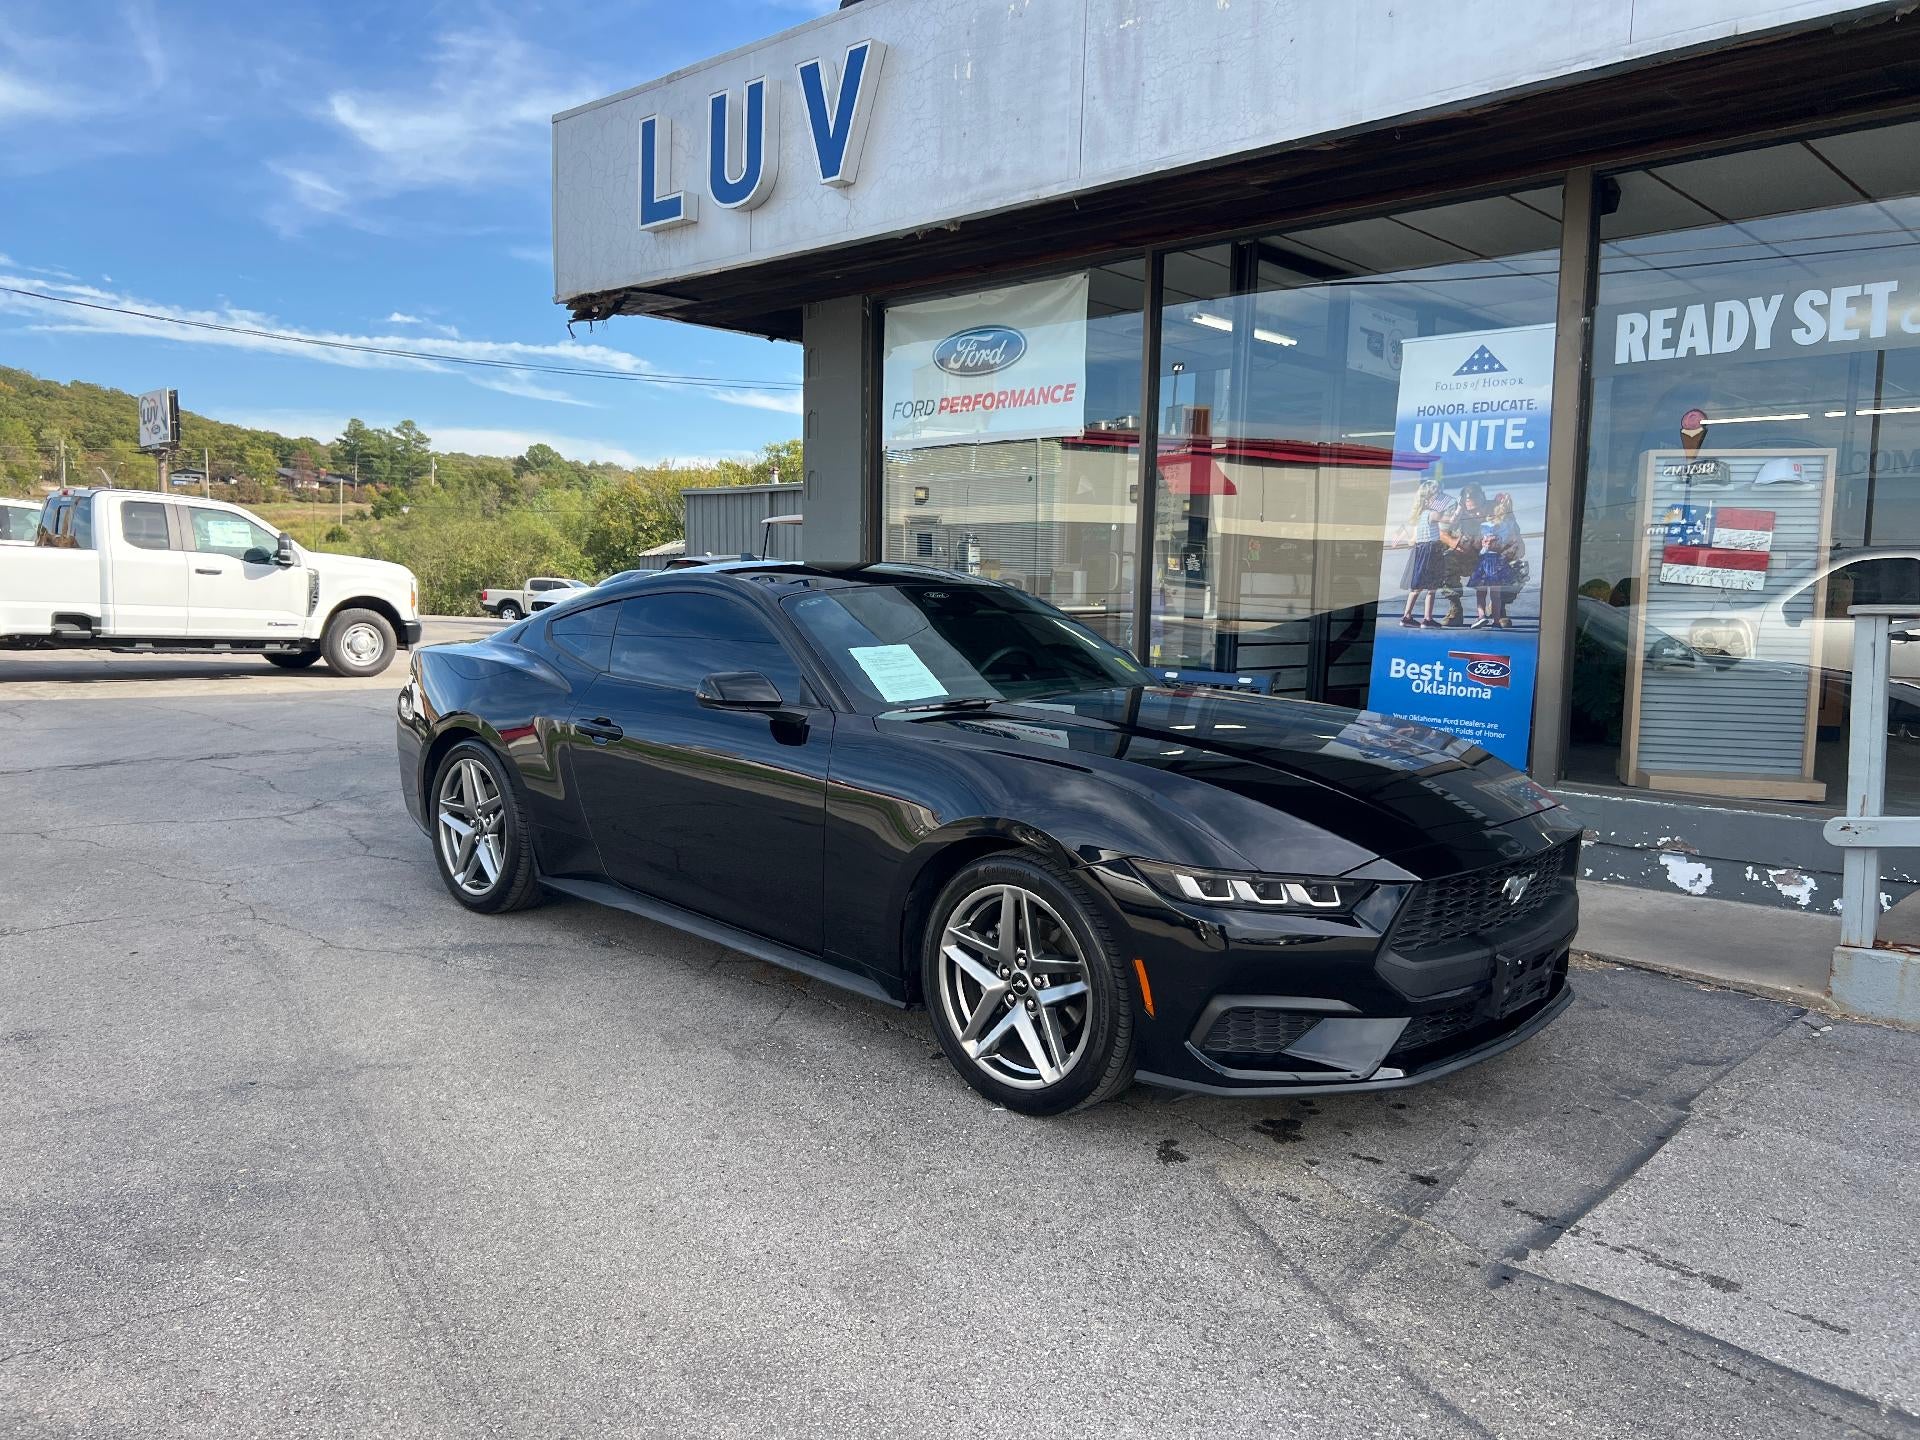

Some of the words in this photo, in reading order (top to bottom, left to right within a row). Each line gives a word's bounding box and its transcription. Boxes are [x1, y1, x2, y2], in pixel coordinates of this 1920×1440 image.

[638, 38, 888, 233] LUV
[1615, 293, 1784, 365] READY
[1791, 280, 1899, 346] SET
[949, 334, 1007, 368] Ford
[1434, 382, 1469, 392] FOLDS
[1469, 380, 1481, 391] of
[1482, 376, 1525, 388] HONOR
[893, 399, 935, 420] FORD
[938, 383, 1077, 415] PERFORMANCE
[1416, 402, 1469, 418] HONOR.
[1472, 398, 1538, 413] EDUCATE.
[142, 404, 159, 426] LUV
[1413, 417, 1535, 454] UNITE.
[1389, 657, 1444, 682] Best
[1448, 667, 1463, 683] in
[1474, 662, 1503, 676] Ford
[1411, 679, 1492, 700] Oklahoma
[1408, 714, 1442, 724] Oklahoma
[1442, 717, 1459, 726] Ford
[1460, 719, 1486, 729] Dealers
[1487, 722, 1499, 730] are
[1455, 727, 1474, 736] Folds
[1475, 729, 1483, 737] of
[1484, 730, 1507, 740] Honor
